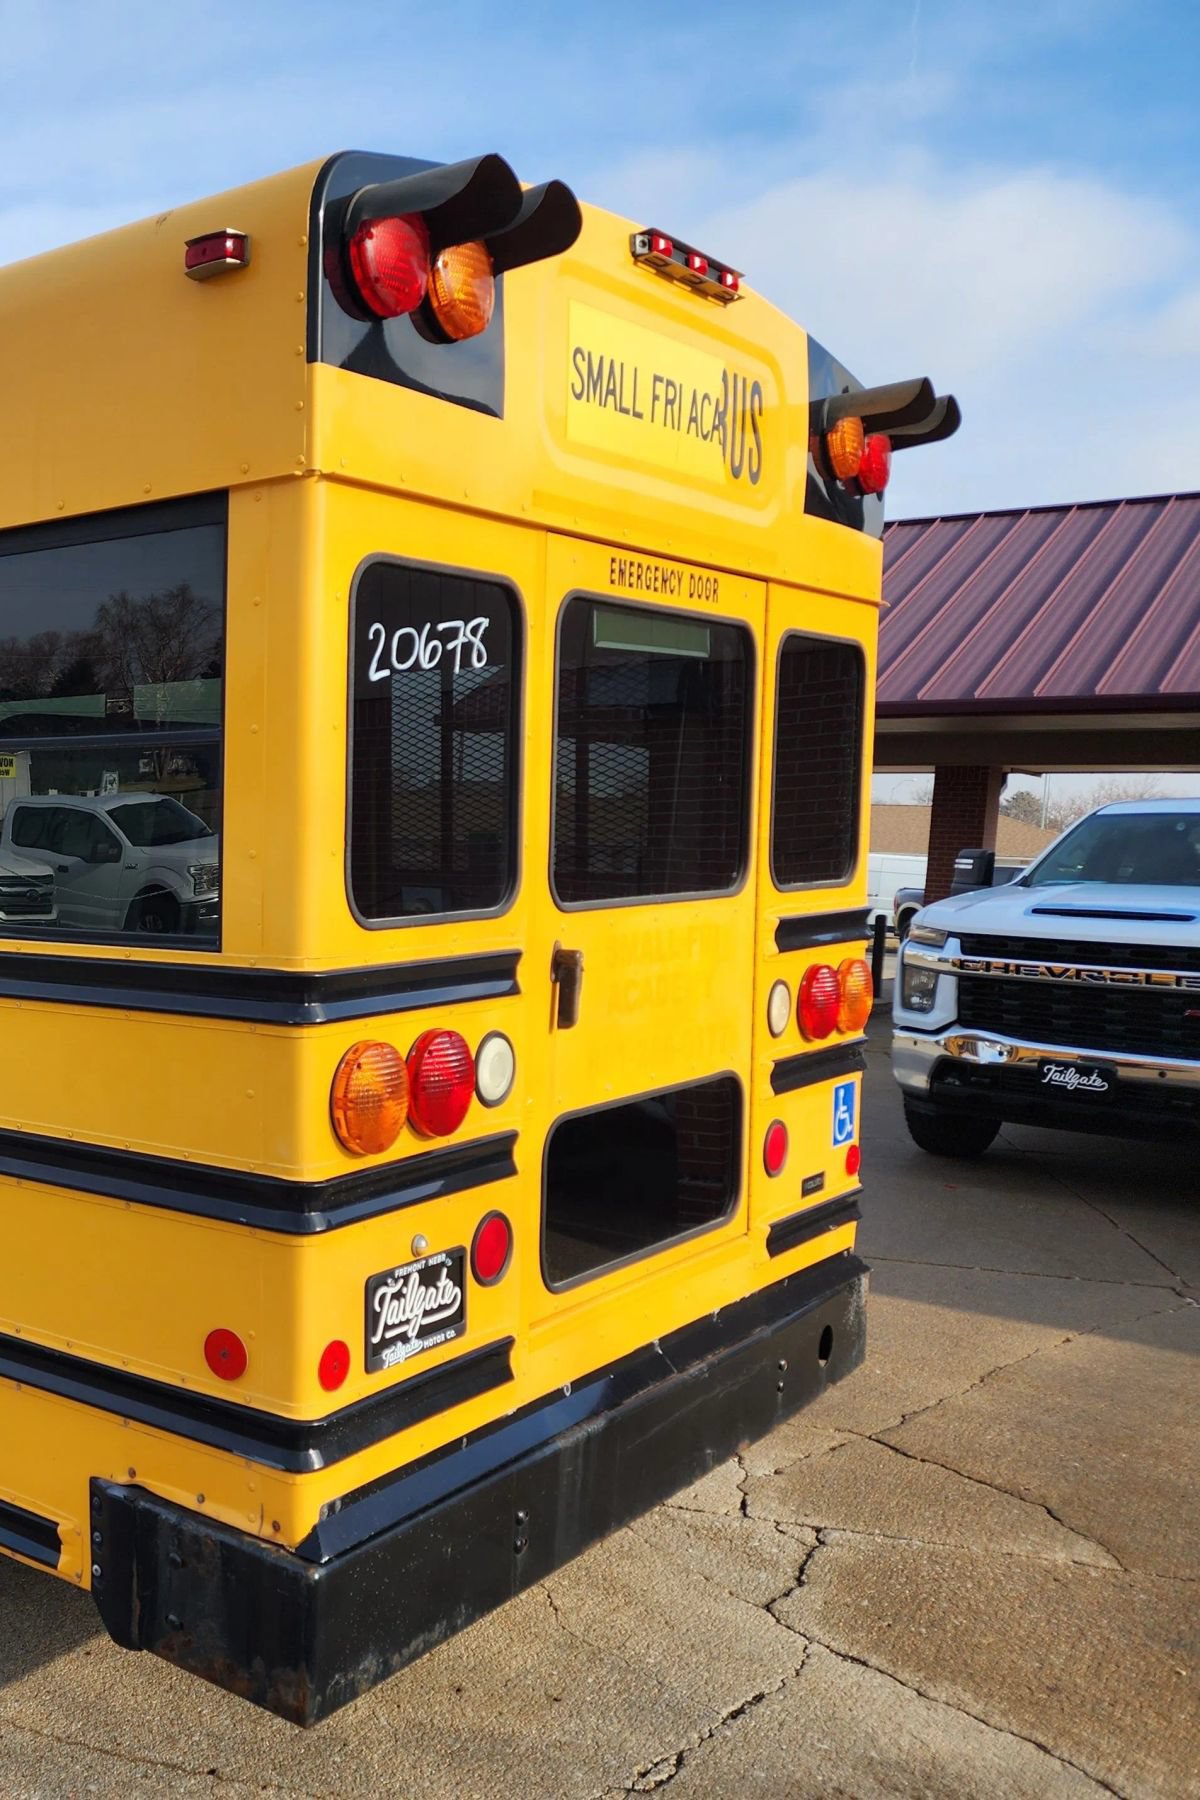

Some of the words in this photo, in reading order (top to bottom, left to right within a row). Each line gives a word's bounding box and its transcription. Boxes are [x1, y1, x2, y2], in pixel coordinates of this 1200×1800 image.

[571, 346, 644, 420] SMALL
[650, 374, 683, 432] FRI
[609, 557, 684, 595] EMERGENCY
[689, 572, 720, 604] DOOR
[368, 616, 490, 682] 20678
[1041, 1063, 1109, 1092] Tailgate
[394, 1261, 426, 1279] FREMONT
[371, 1267, 462, 1345] Tailgate
[382, 1336, 423, 1369] Tailgate
[423, 1334, 446, 1349] MOTOR
